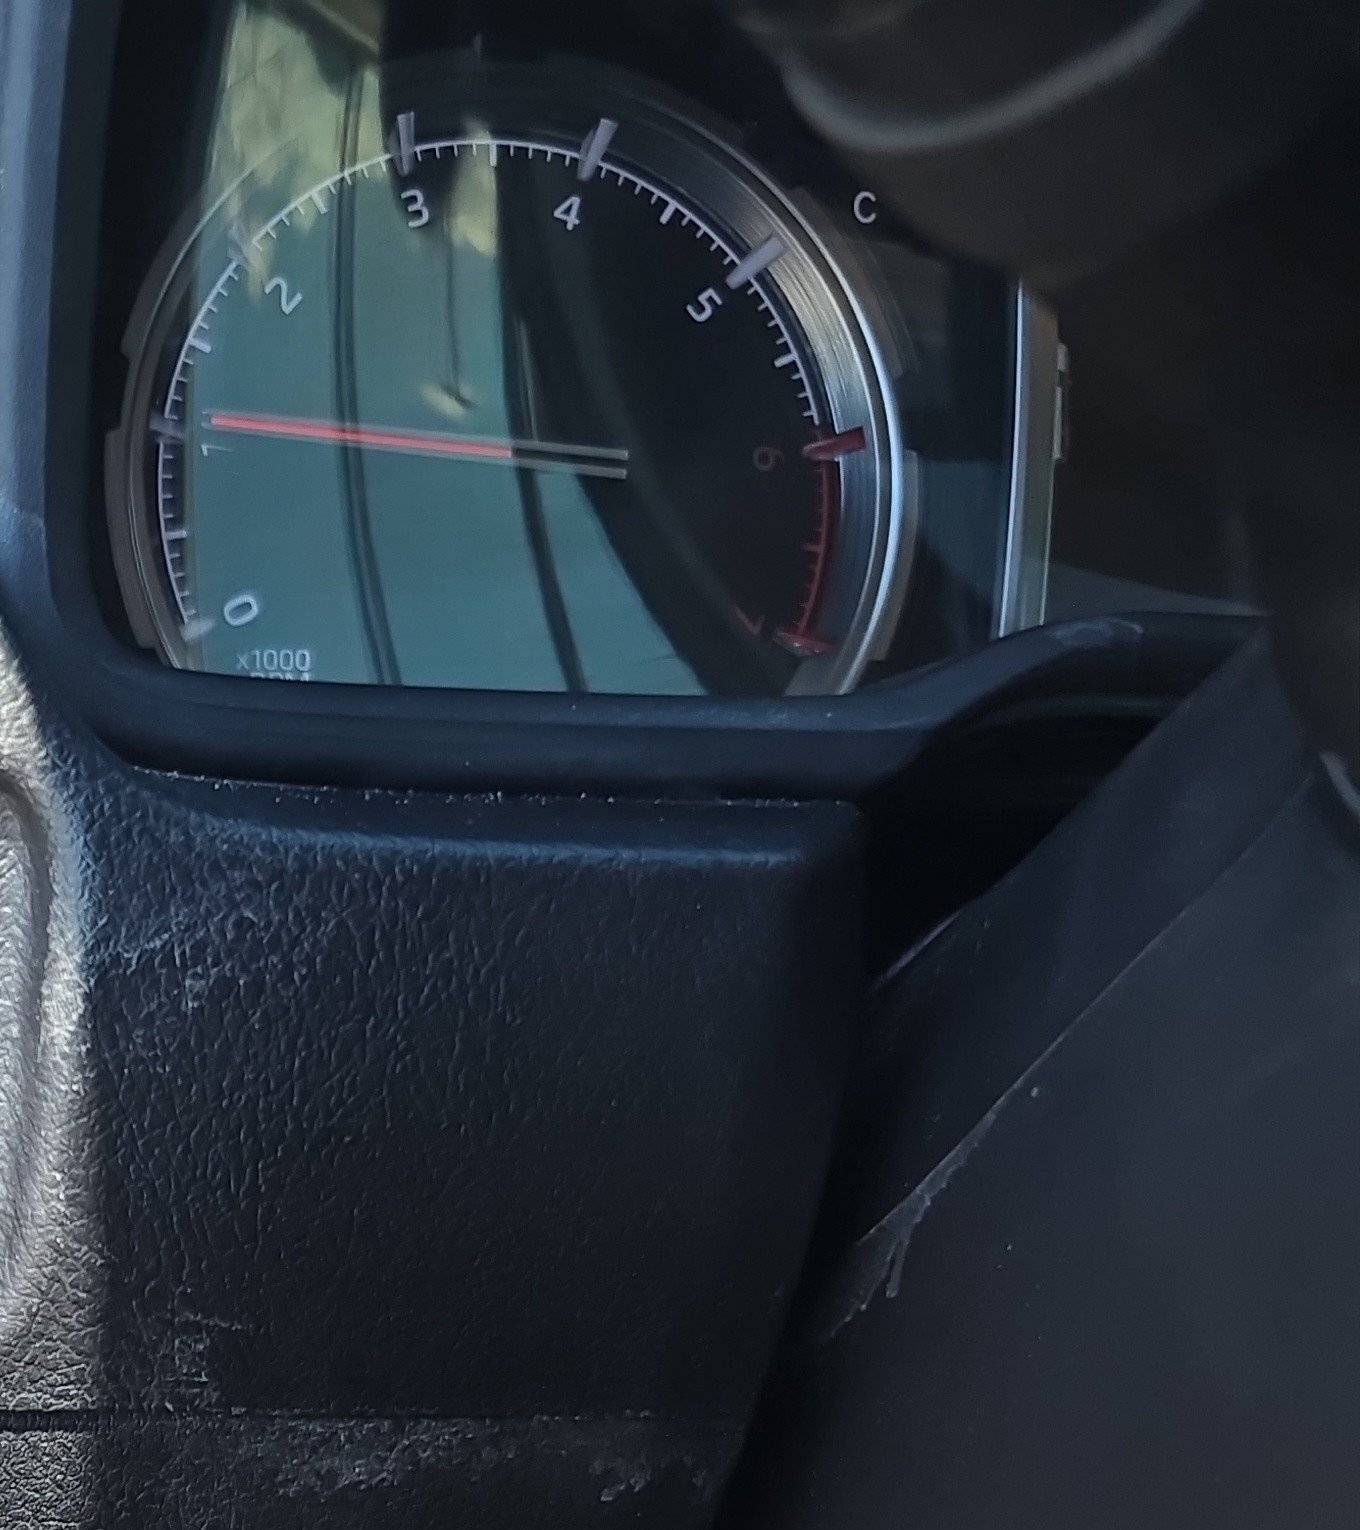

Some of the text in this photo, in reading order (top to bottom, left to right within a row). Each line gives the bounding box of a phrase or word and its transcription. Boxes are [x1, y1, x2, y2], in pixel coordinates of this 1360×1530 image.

[401, 189, 430, 228] 3
[553, 196, 582, 231] 4
[853, 191, 877, 224] C
[264, 277, 303, 315] 2
[686, 288, 723, 322] 5
[223, 594, 258, 626] 0
